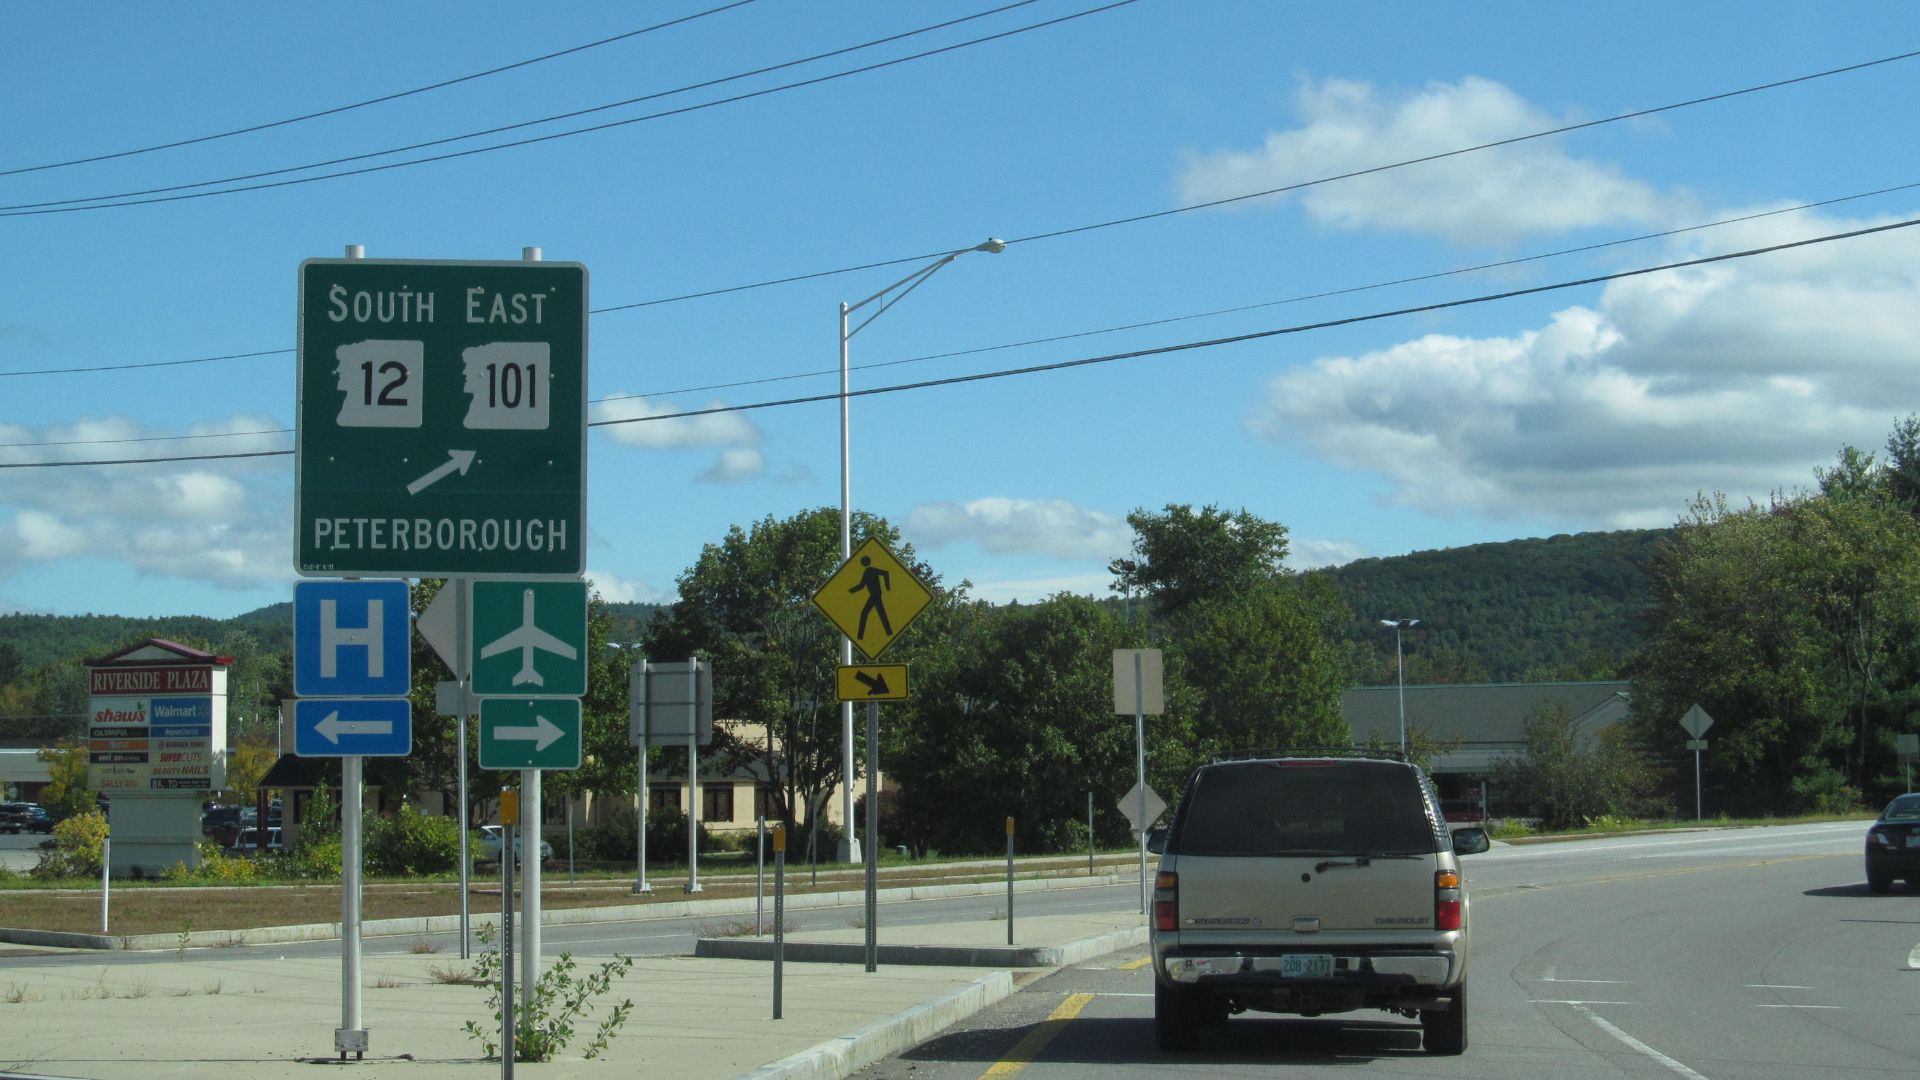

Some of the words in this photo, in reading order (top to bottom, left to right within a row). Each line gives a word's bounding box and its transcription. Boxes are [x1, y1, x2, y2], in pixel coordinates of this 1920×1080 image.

[328, 285, 434, 323] SOUTH
[466, 287, 547, 325] EAST
[361, 360, 408, 406] 12
[486, 362, 536, 409] 101
[314, 518, 567, 551] PETERBOROUGH
[320, 599, 384, 678] H
[94, 672, 161, 690] RIVERSIDE
[167, 671, 208, 689] PLAZA
[155, 705, 197, 717] Walmart
[182, 766, 208, 774] NAILS
[1306, 959, 1330, 972] 2177
